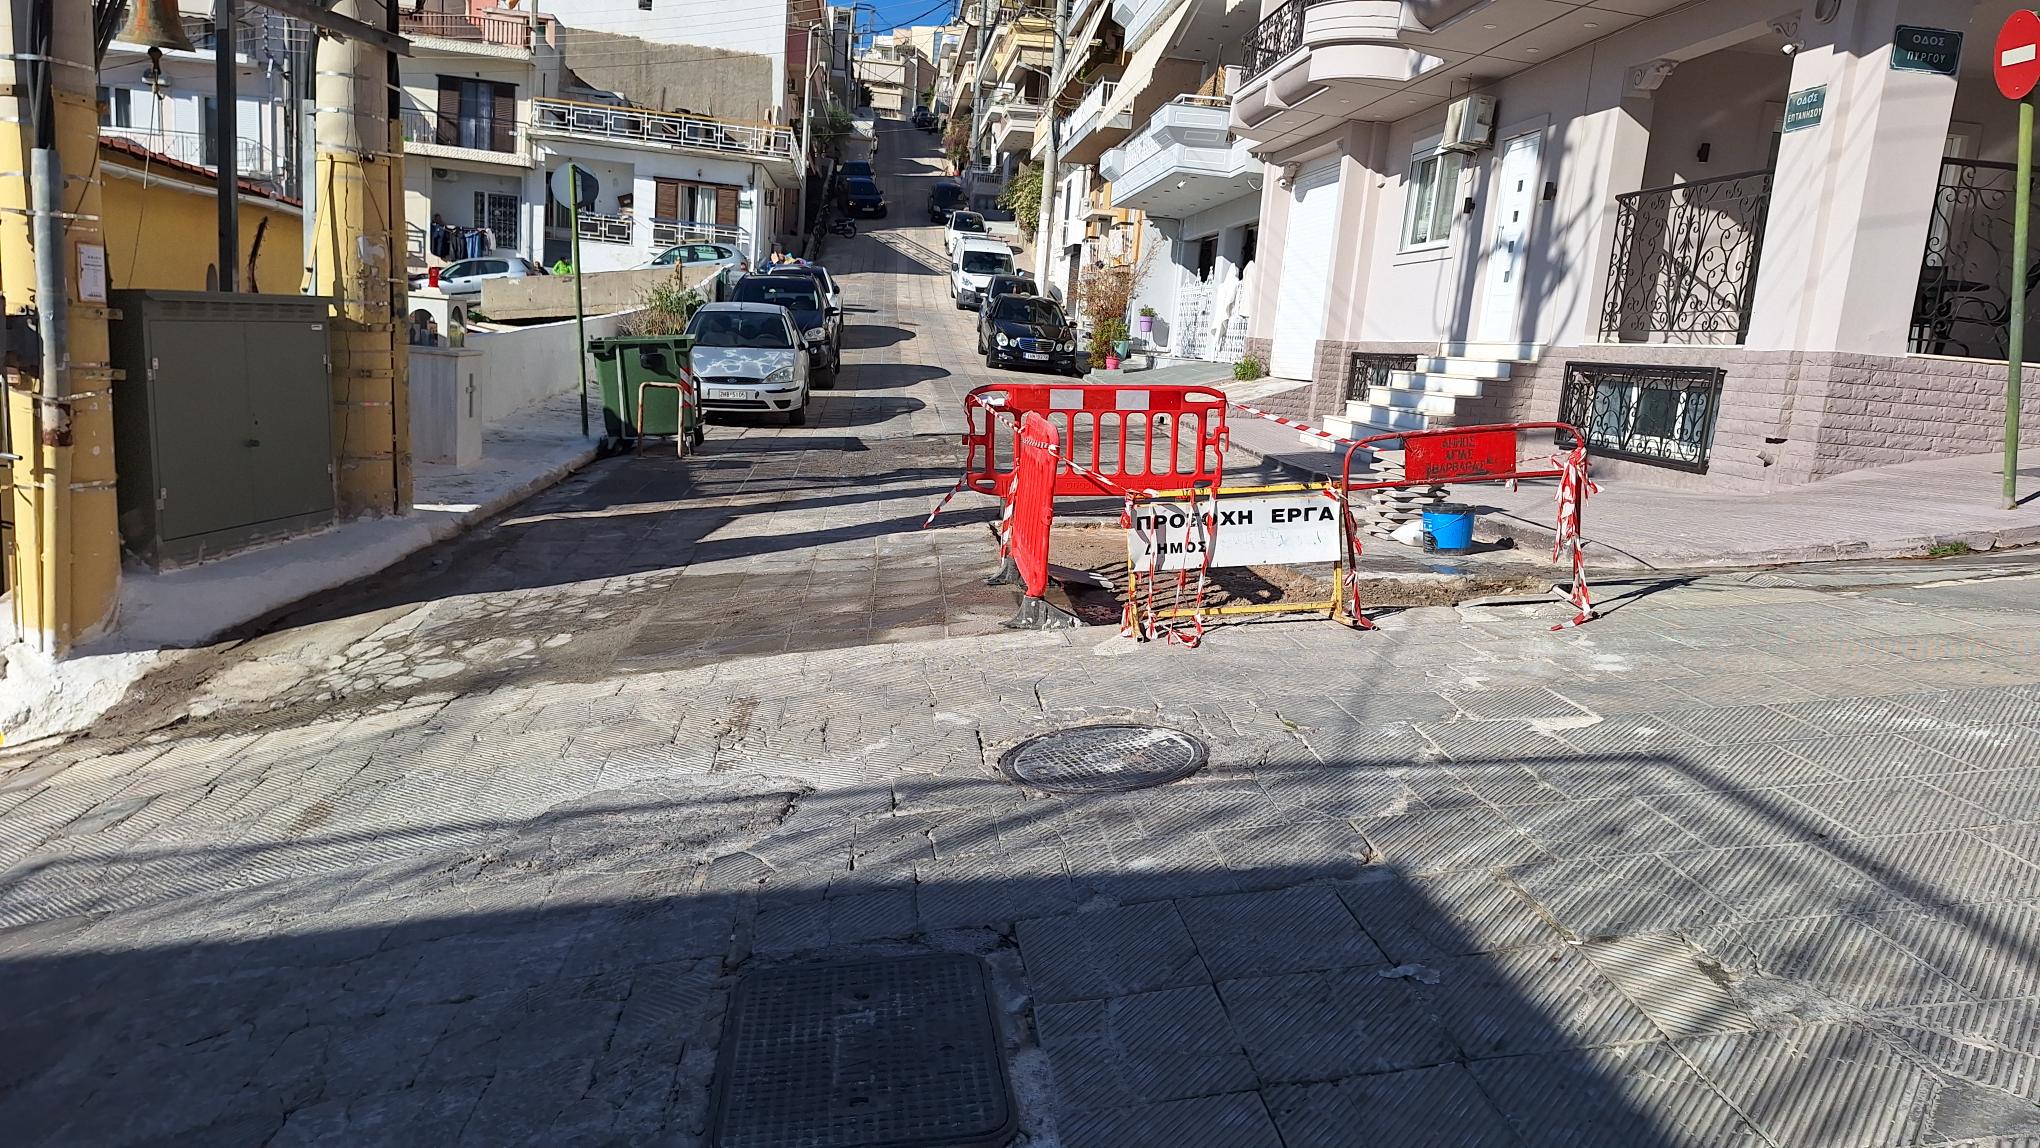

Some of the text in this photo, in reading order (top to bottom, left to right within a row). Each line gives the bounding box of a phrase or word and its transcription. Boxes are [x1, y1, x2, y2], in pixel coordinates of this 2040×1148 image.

[1912, 34, 1945, 46] ΟΔΟΣ
[1907, 50, 1946, 63] ΠΥΡΓΟΥ
[1787, 107, 1823, 123] ΕΠΤΑΝΗΣΟΥ
[1136, 506, 1336, 531] ΠΡΟΣΟΧΗ ΕΡΓΑ
